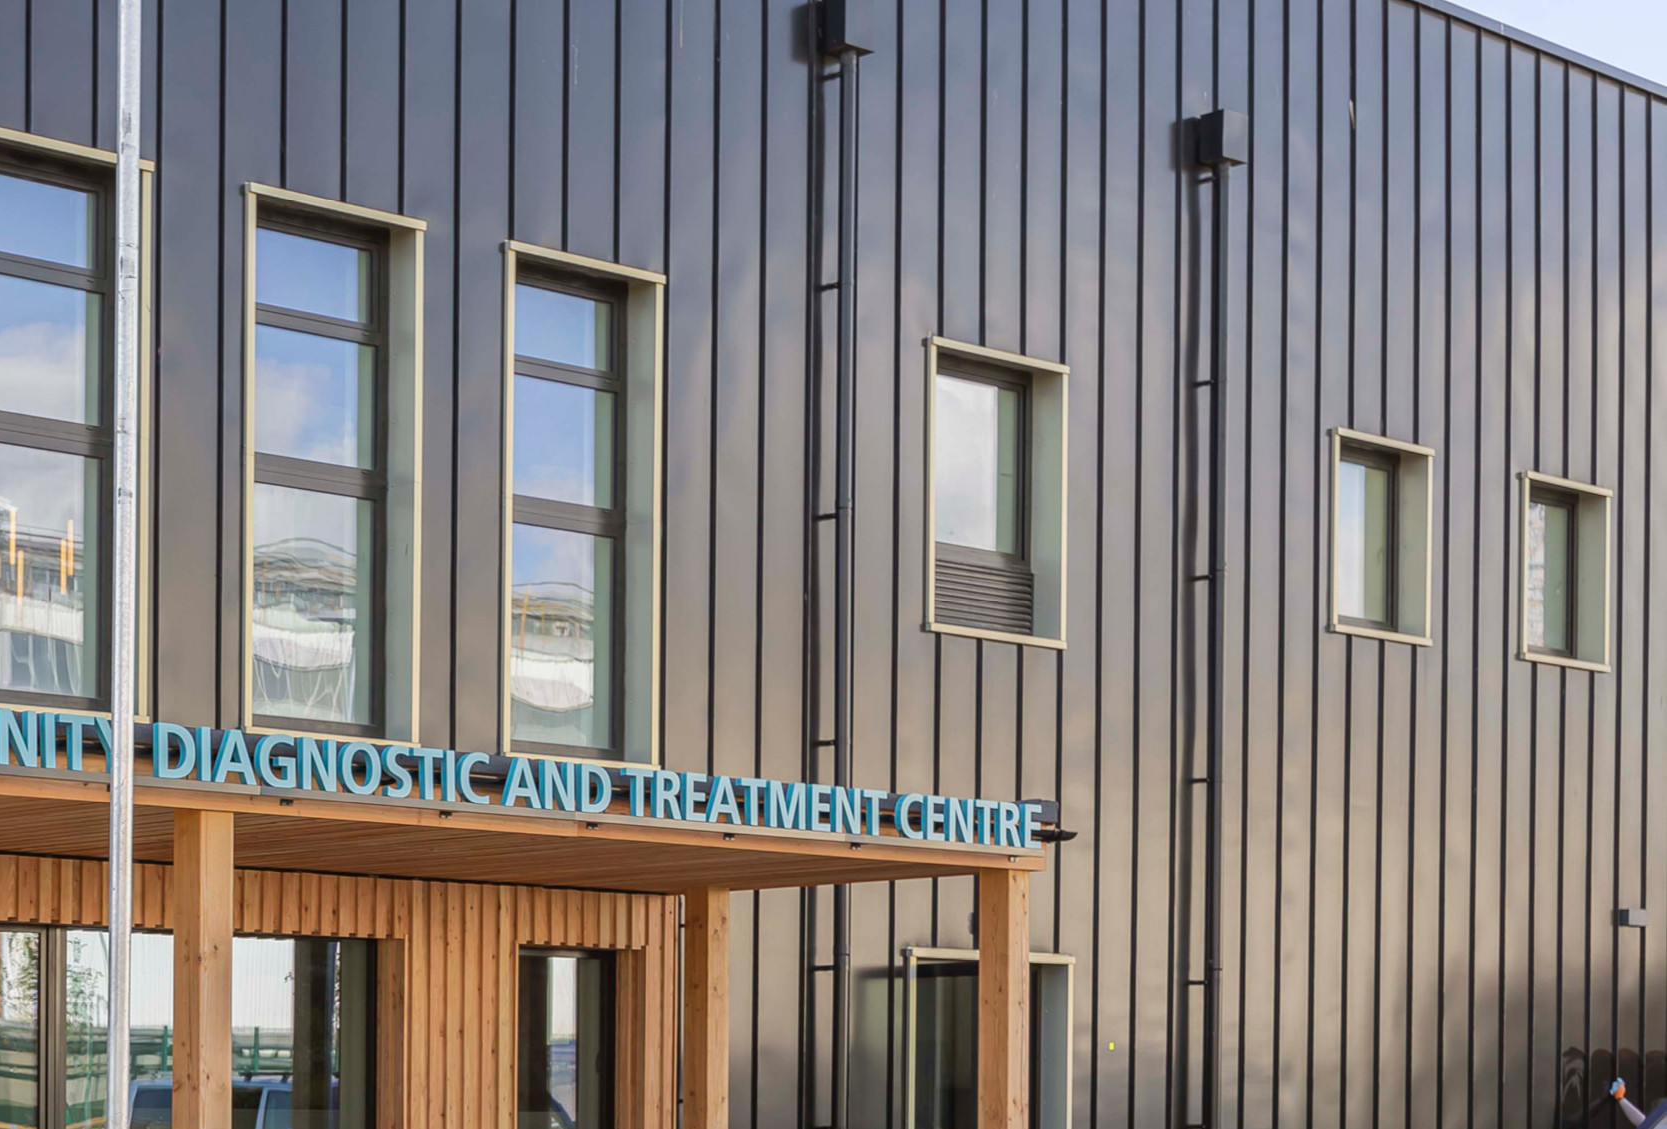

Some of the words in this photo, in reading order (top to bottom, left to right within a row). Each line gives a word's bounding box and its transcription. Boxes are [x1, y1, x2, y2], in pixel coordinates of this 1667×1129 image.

[152, 721, 490, 805] DIAGNOSTIC
[500, 757, 613, 814] AND
[618, 766, 888, 836] TREATMENT
[893, 792, 1043, 849] CENTRE
